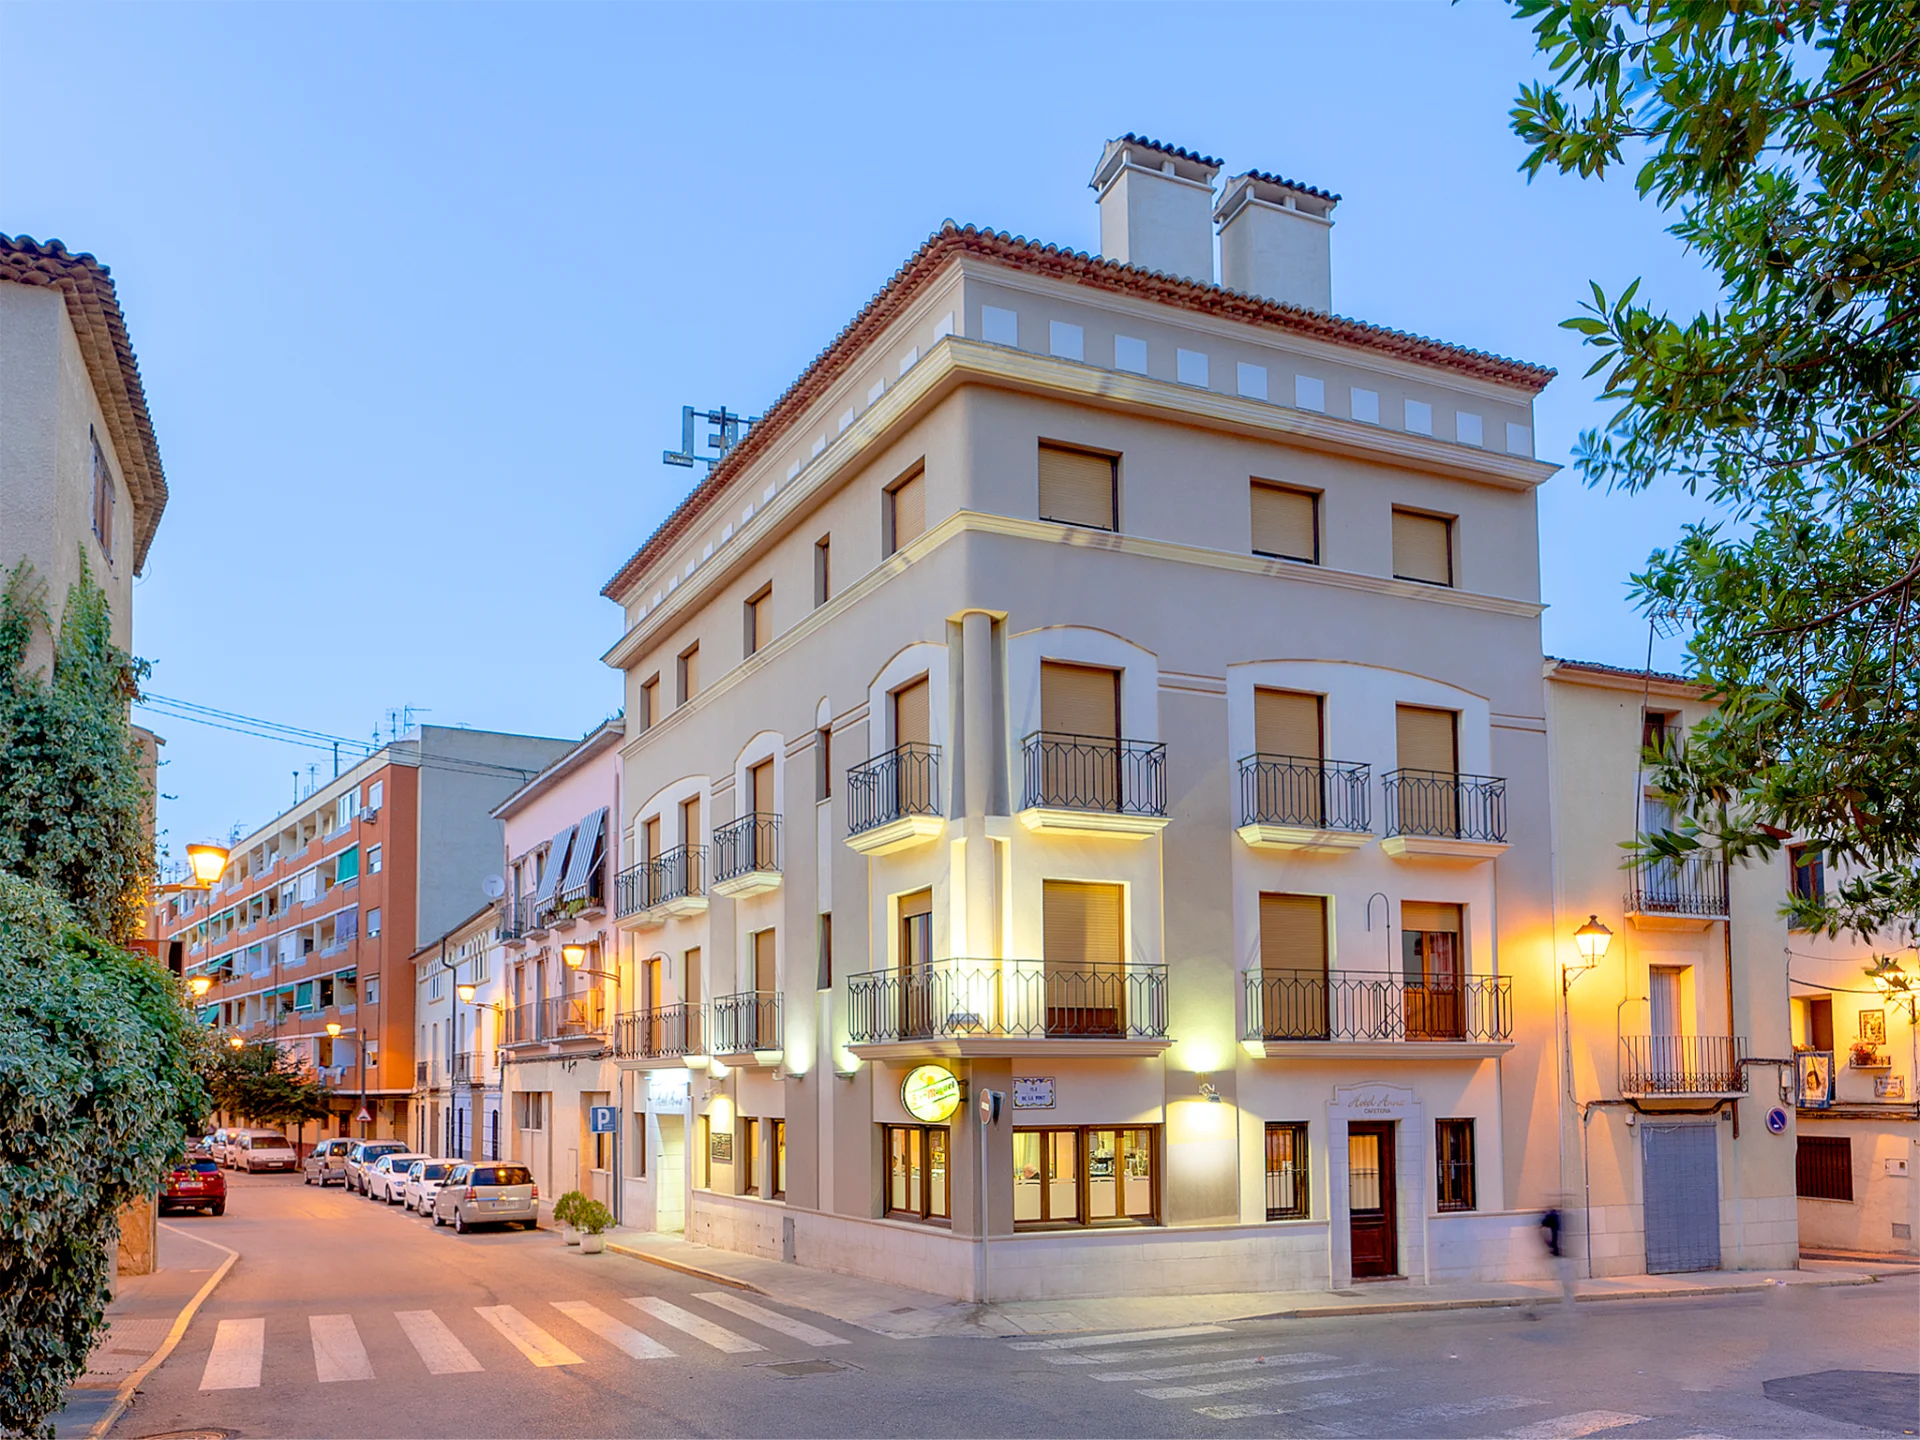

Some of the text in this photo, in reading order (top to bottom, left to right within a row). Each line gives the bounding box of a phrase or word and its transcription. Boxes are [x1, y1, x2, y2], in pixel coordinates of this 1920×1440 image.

[1347, 1094, 1405, 1108] Hotel Anna
[598, 1108, 610, 1130] P
